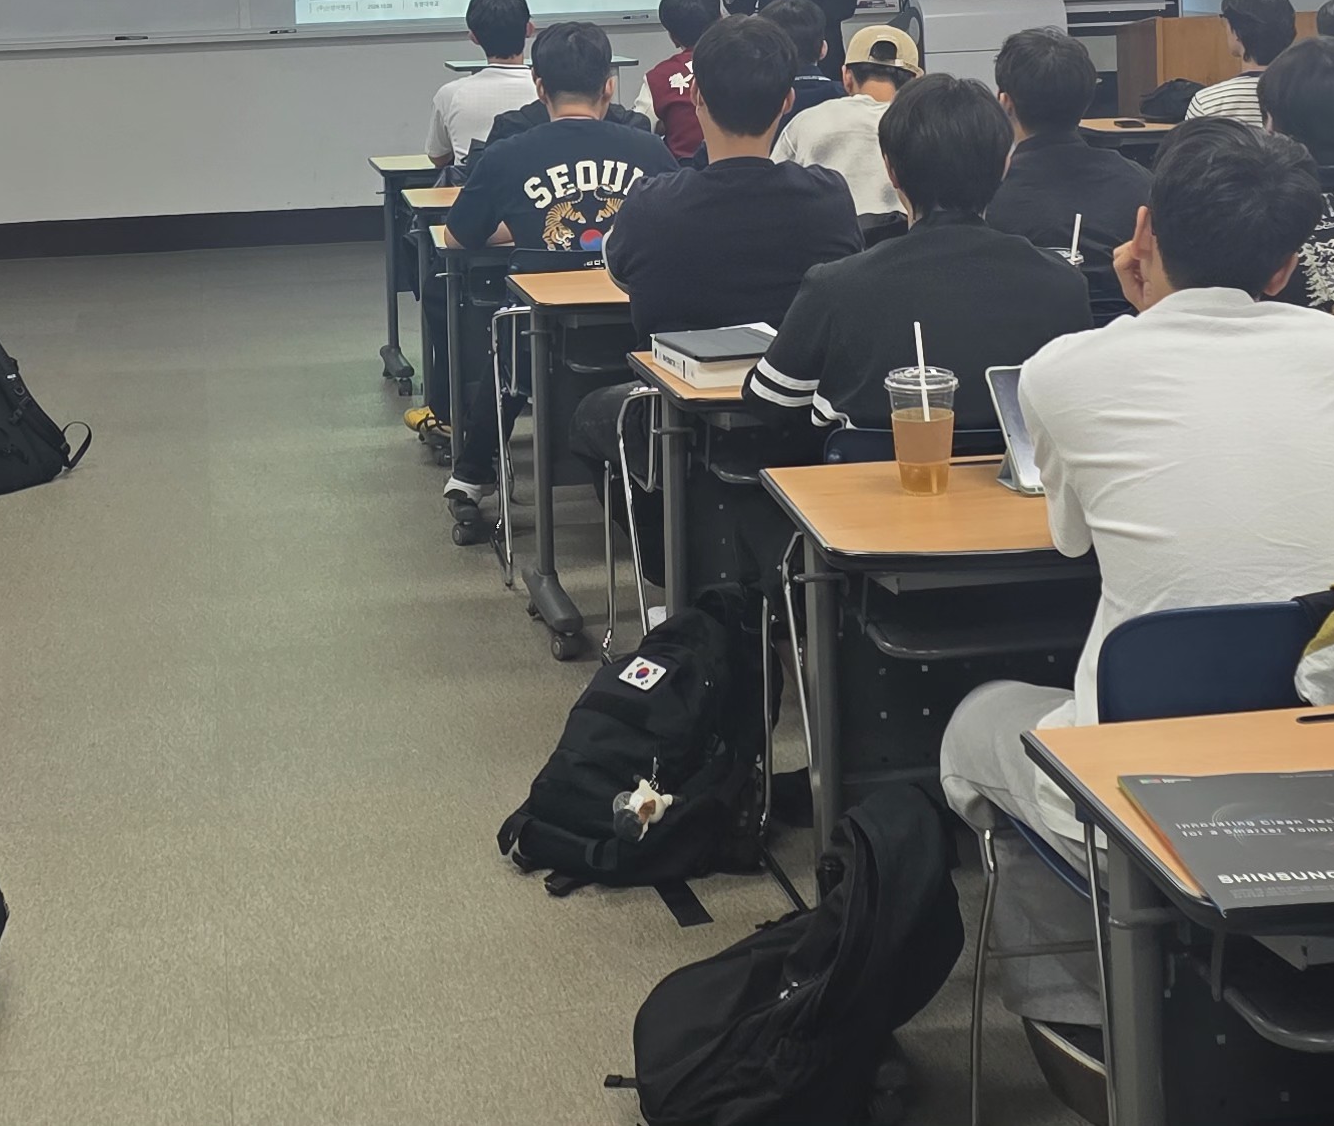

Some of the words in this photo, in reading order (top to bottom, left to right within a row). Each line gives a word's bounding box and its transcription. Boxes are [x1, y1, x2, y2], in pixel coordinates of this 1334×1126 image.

[1175, 820, 1256, 830] Innovating
[1259, 818, 1303, 826] Clean
[1223, 826, 1283, 835] Smarter
